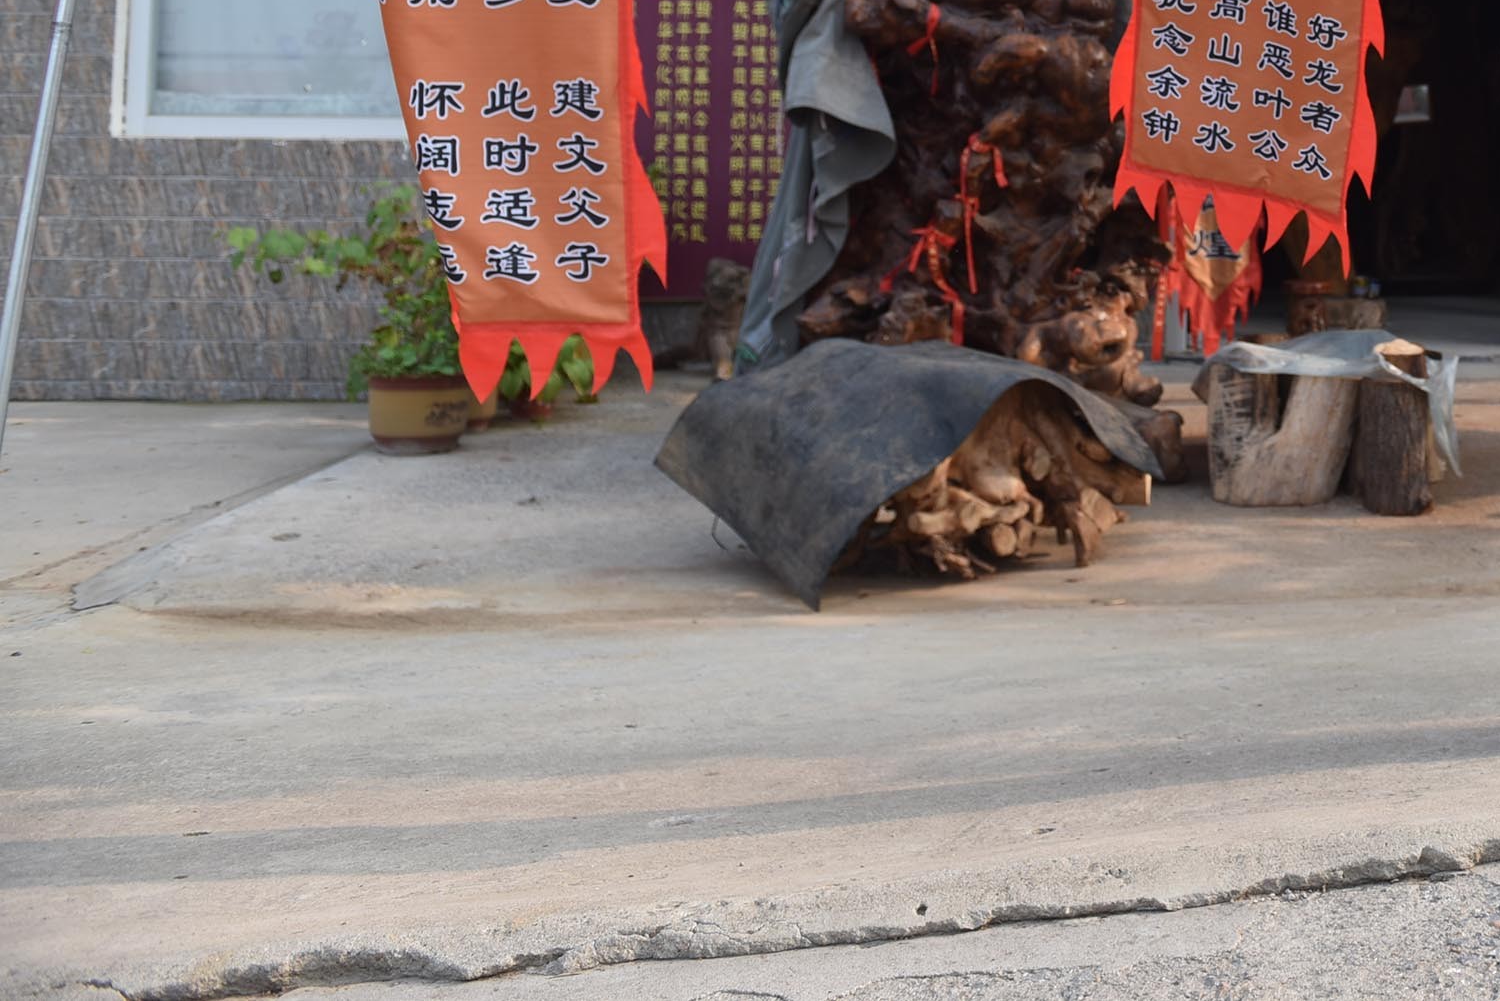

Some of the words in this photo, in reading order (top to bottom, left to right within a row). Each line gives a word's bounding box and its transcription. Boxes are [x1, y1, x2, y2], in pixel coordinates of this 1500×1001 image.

[480, 77, 540, 283] 此时适逢
[549, 75, 610, 283] 建文父子
[1292, 12, 1346, 180] 好龙者众
